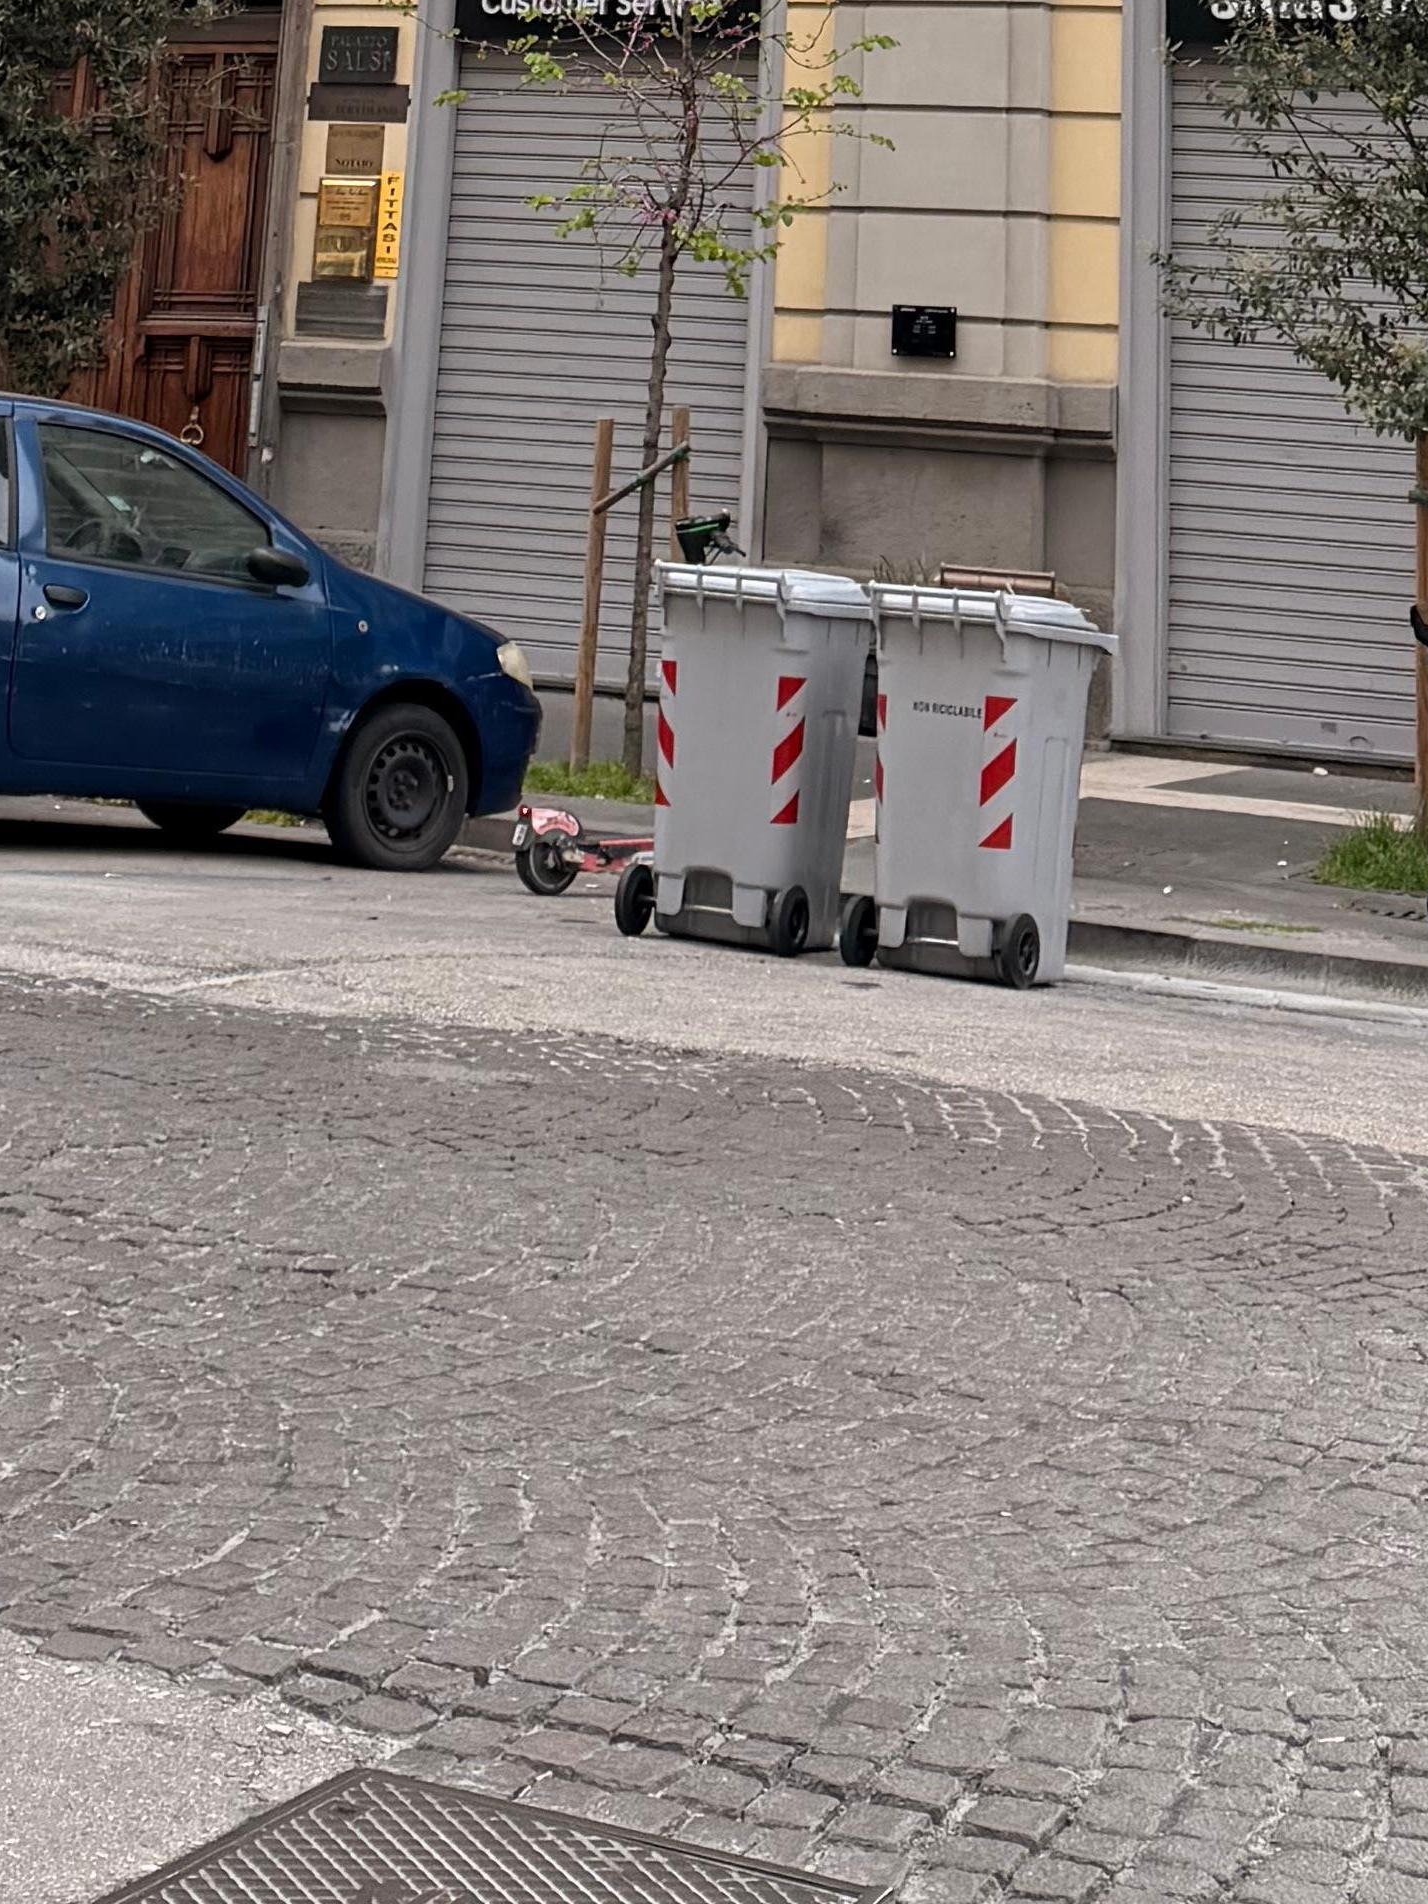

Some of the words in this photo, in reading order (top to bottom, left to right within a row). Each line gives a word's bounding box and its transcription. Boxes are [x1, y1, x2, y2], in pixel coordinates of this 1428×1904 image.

[381, 176, 400, 254] FITTASI
[912, 700, 930, 713] NON
[932, 702, 982, 719] RICICLABILE
